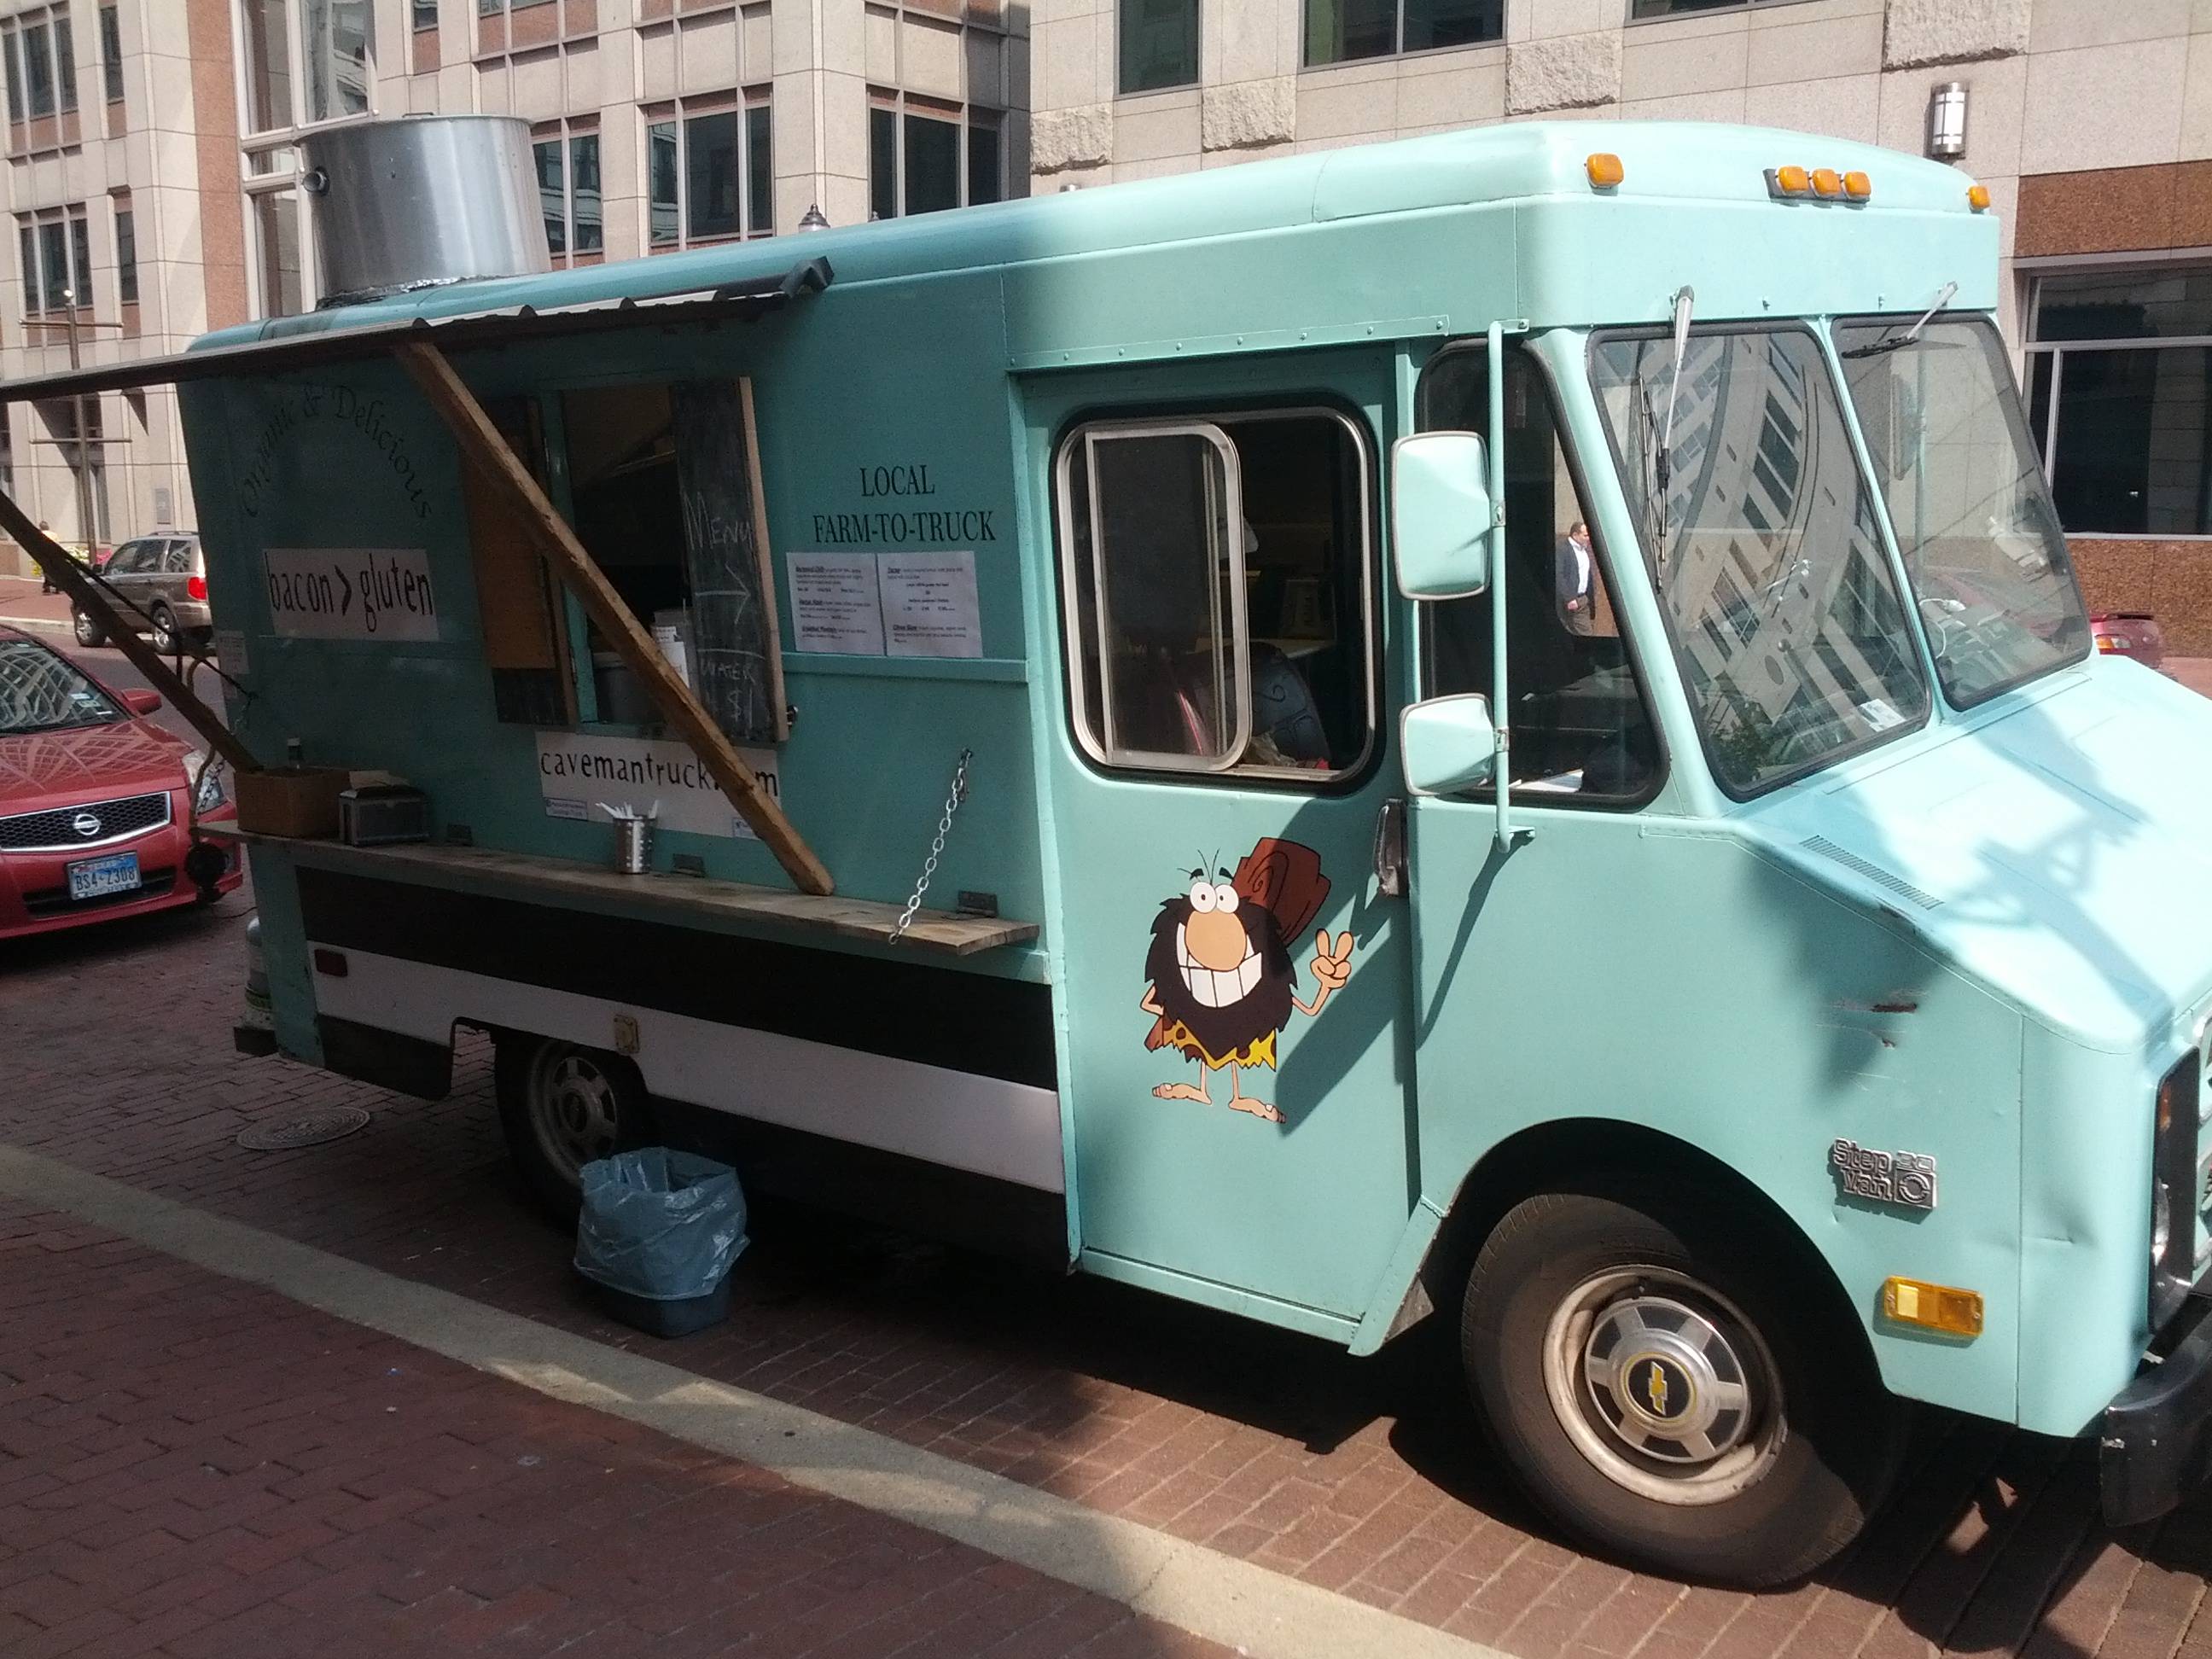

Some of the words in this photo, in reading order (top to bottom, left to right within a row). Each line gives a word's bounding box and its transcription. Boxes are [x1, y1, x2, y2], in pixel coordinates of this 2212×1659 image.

[331, 384, 434, 518] Delicious
[859, 464, 935, 497] LOCAL
[812, 510, 997, 544] FARM-TO-TRUCK
[265, 551, 335, 614] bacon
[359, 552, 434, 632] gluten
[539, 751, 778, 797] cavemantruck.m
[1832, 1137, 1892, 1174] Step
[1840, 1166, 1893, 1202] Van
